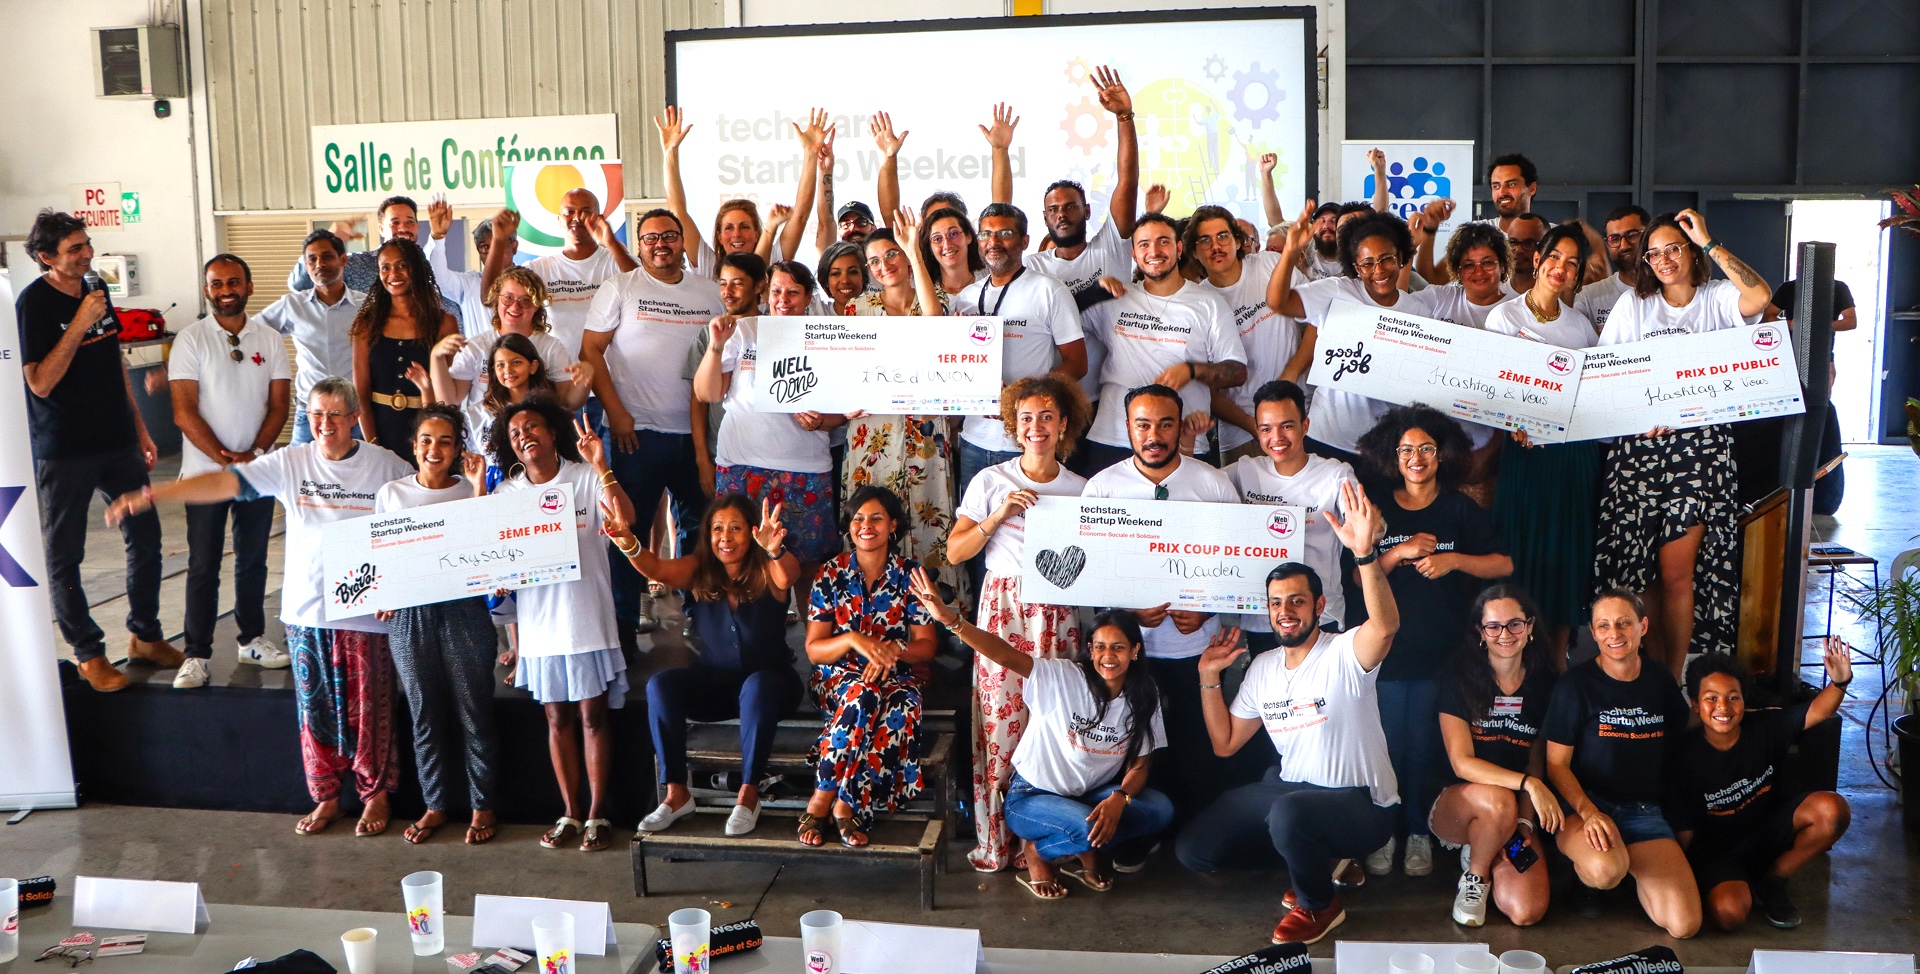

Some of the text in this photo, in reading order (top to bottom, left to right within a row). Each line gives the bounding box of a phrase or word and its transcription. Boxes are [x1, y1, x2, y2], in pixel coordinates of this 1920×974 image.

[324, 140, 393, 193] Salle
[403, 147, 432, 191] de
[717, 152, 850, 189] Startp
[85, 188, 106, 206] PC
[123, 214, 141, 224] DAE
[547, 283, 601, 294] Startup Weeke
[638, 298, 684, 309] techstars_
[638, 305, 711, 316] Startup Weekend
[1242, 301, 1267, 320] Weeke
[1003, 319, 1027, 327] kend
[1120, 310, 1164, 325] techstars_
[1378, 314, 1424, 332] techstars_
[805, 323, 850, 332] techstars_
[1116, 318, 1192, 335] Startup Weekend
[1376, 322, 1452, 345] Startup Weekend
[805, 332, 877, 341] Startup Weekend
[1325, 341, 1364, 366] good
[1398, 339, 1418, 350] Sociale
[1424, 345, 1447, 355] Solidaire
[937, 354, 988, 364] 1ER PRIX
[1582, 355, 1651, 370] artup Weekend
[1585, 352, 1619, 361] hstars_
[772, 355, 812, 378] WELL
[1333, 353, 1372, 382] job
[1627, 367, 1652, 376] Solidaire
[1676, 356, 1780, 380] PRIX DU PUBLIC
[769, 371, 818, 404] Done
[1428, 366, 1549, 406] Hashtag & Vous
[1498, 369, 1563, 393] 2ÈME PRIX
[1644, 376, 1769, 406] Hashtag & Vous
[302, 479, 346, 491] techstars_
[299, 487, 375, 501] Startup Weekend
[1080, 505, 1131, 517] techstars_
[370, 516, 416, 529] techstars_
[1080, 515, 1163, 528] Startup Weekend
[1273, 515, 1288, 523] Web
[370, 519, 445, 538] Startup Weekend
[498, 521, 562, 541] 3ÈME PRIX
[397, 537, 416, 546] Sociale
[422, 533, 445, 542] Solidaire
[1149, 542, 1289, 559] PRIX COUP DE COEUR
[1504, 719, 1538, 735] Weeke
[1599, 714, 1664, 727] Startup Weeke
[1599, 723, 1612, 731] ESS
[1599, 730, 1630, 739] Economie
[1630, 731, 1651, 739] Sociale
[1704, 778, 1752, 801] techstars_
[25, 891, 54, 902] Solida
[710, 919, 759, 936] Weeke
[710, 945, 734, 957] ociale
[736, 943, 746, 951] et
[810, 955, 824, 963] Web
[1205, 953, 1268, 974] chstars_
[1632, 959, 1681, 974] Weeke
